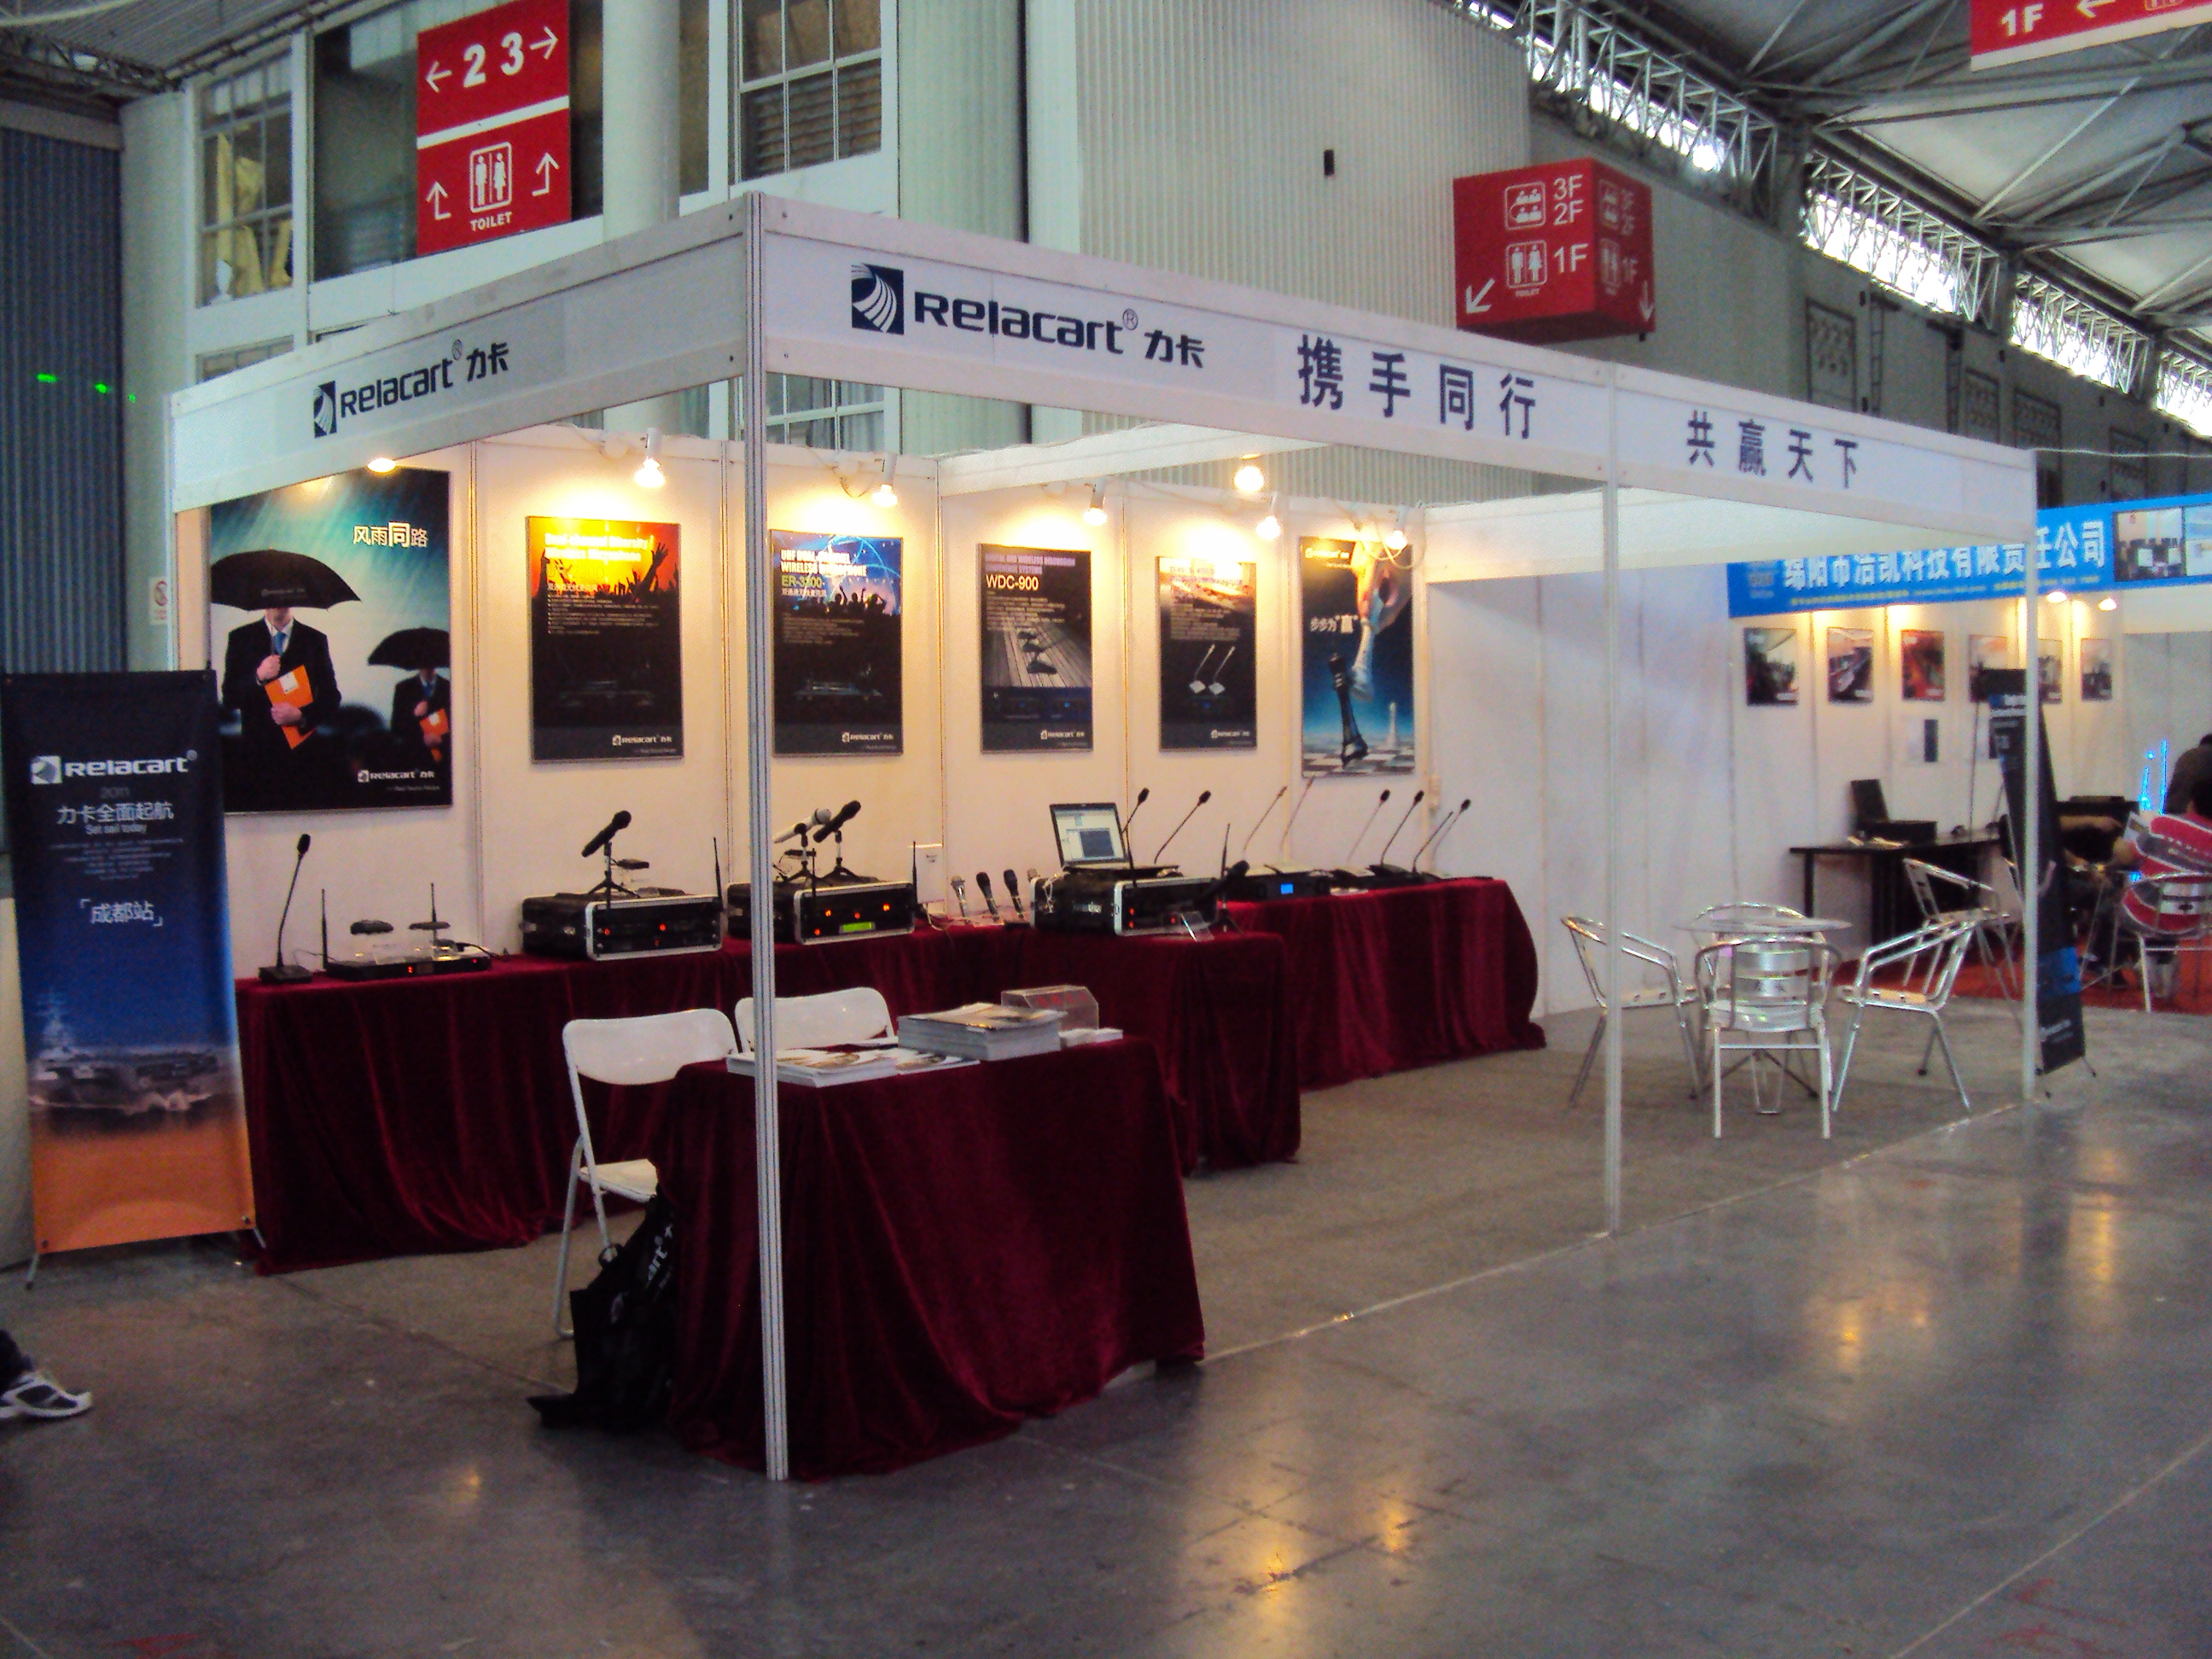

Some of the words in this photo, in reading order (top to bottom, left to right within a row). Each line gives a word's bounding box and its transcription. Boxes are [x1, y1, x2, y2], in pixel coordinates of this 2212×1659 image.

[2000, 3, 2044, 37] 1F
[463, 44, 486, 88] 2
[500, 32, 524, 76] 3
[1552, 174, 1584, 200] 3F
[469, 212, 512, 231] TOILET
[1552, 200, 1585, 226] 2F
[1552, 243, 1589, 273] 1F
[467, 342, 509, 381] 力卡
[1144, 329, 1205, 368] 力卡
[1297, 335, 1536, 439] 携手同行
[1686, 410, 1858, 488] 共赢天下
[352, 521, 428, 548] 风雨同路
[987, 574, 1039, 591] WDC-900
[56, 800, 175, 824] 力卡全面起航
